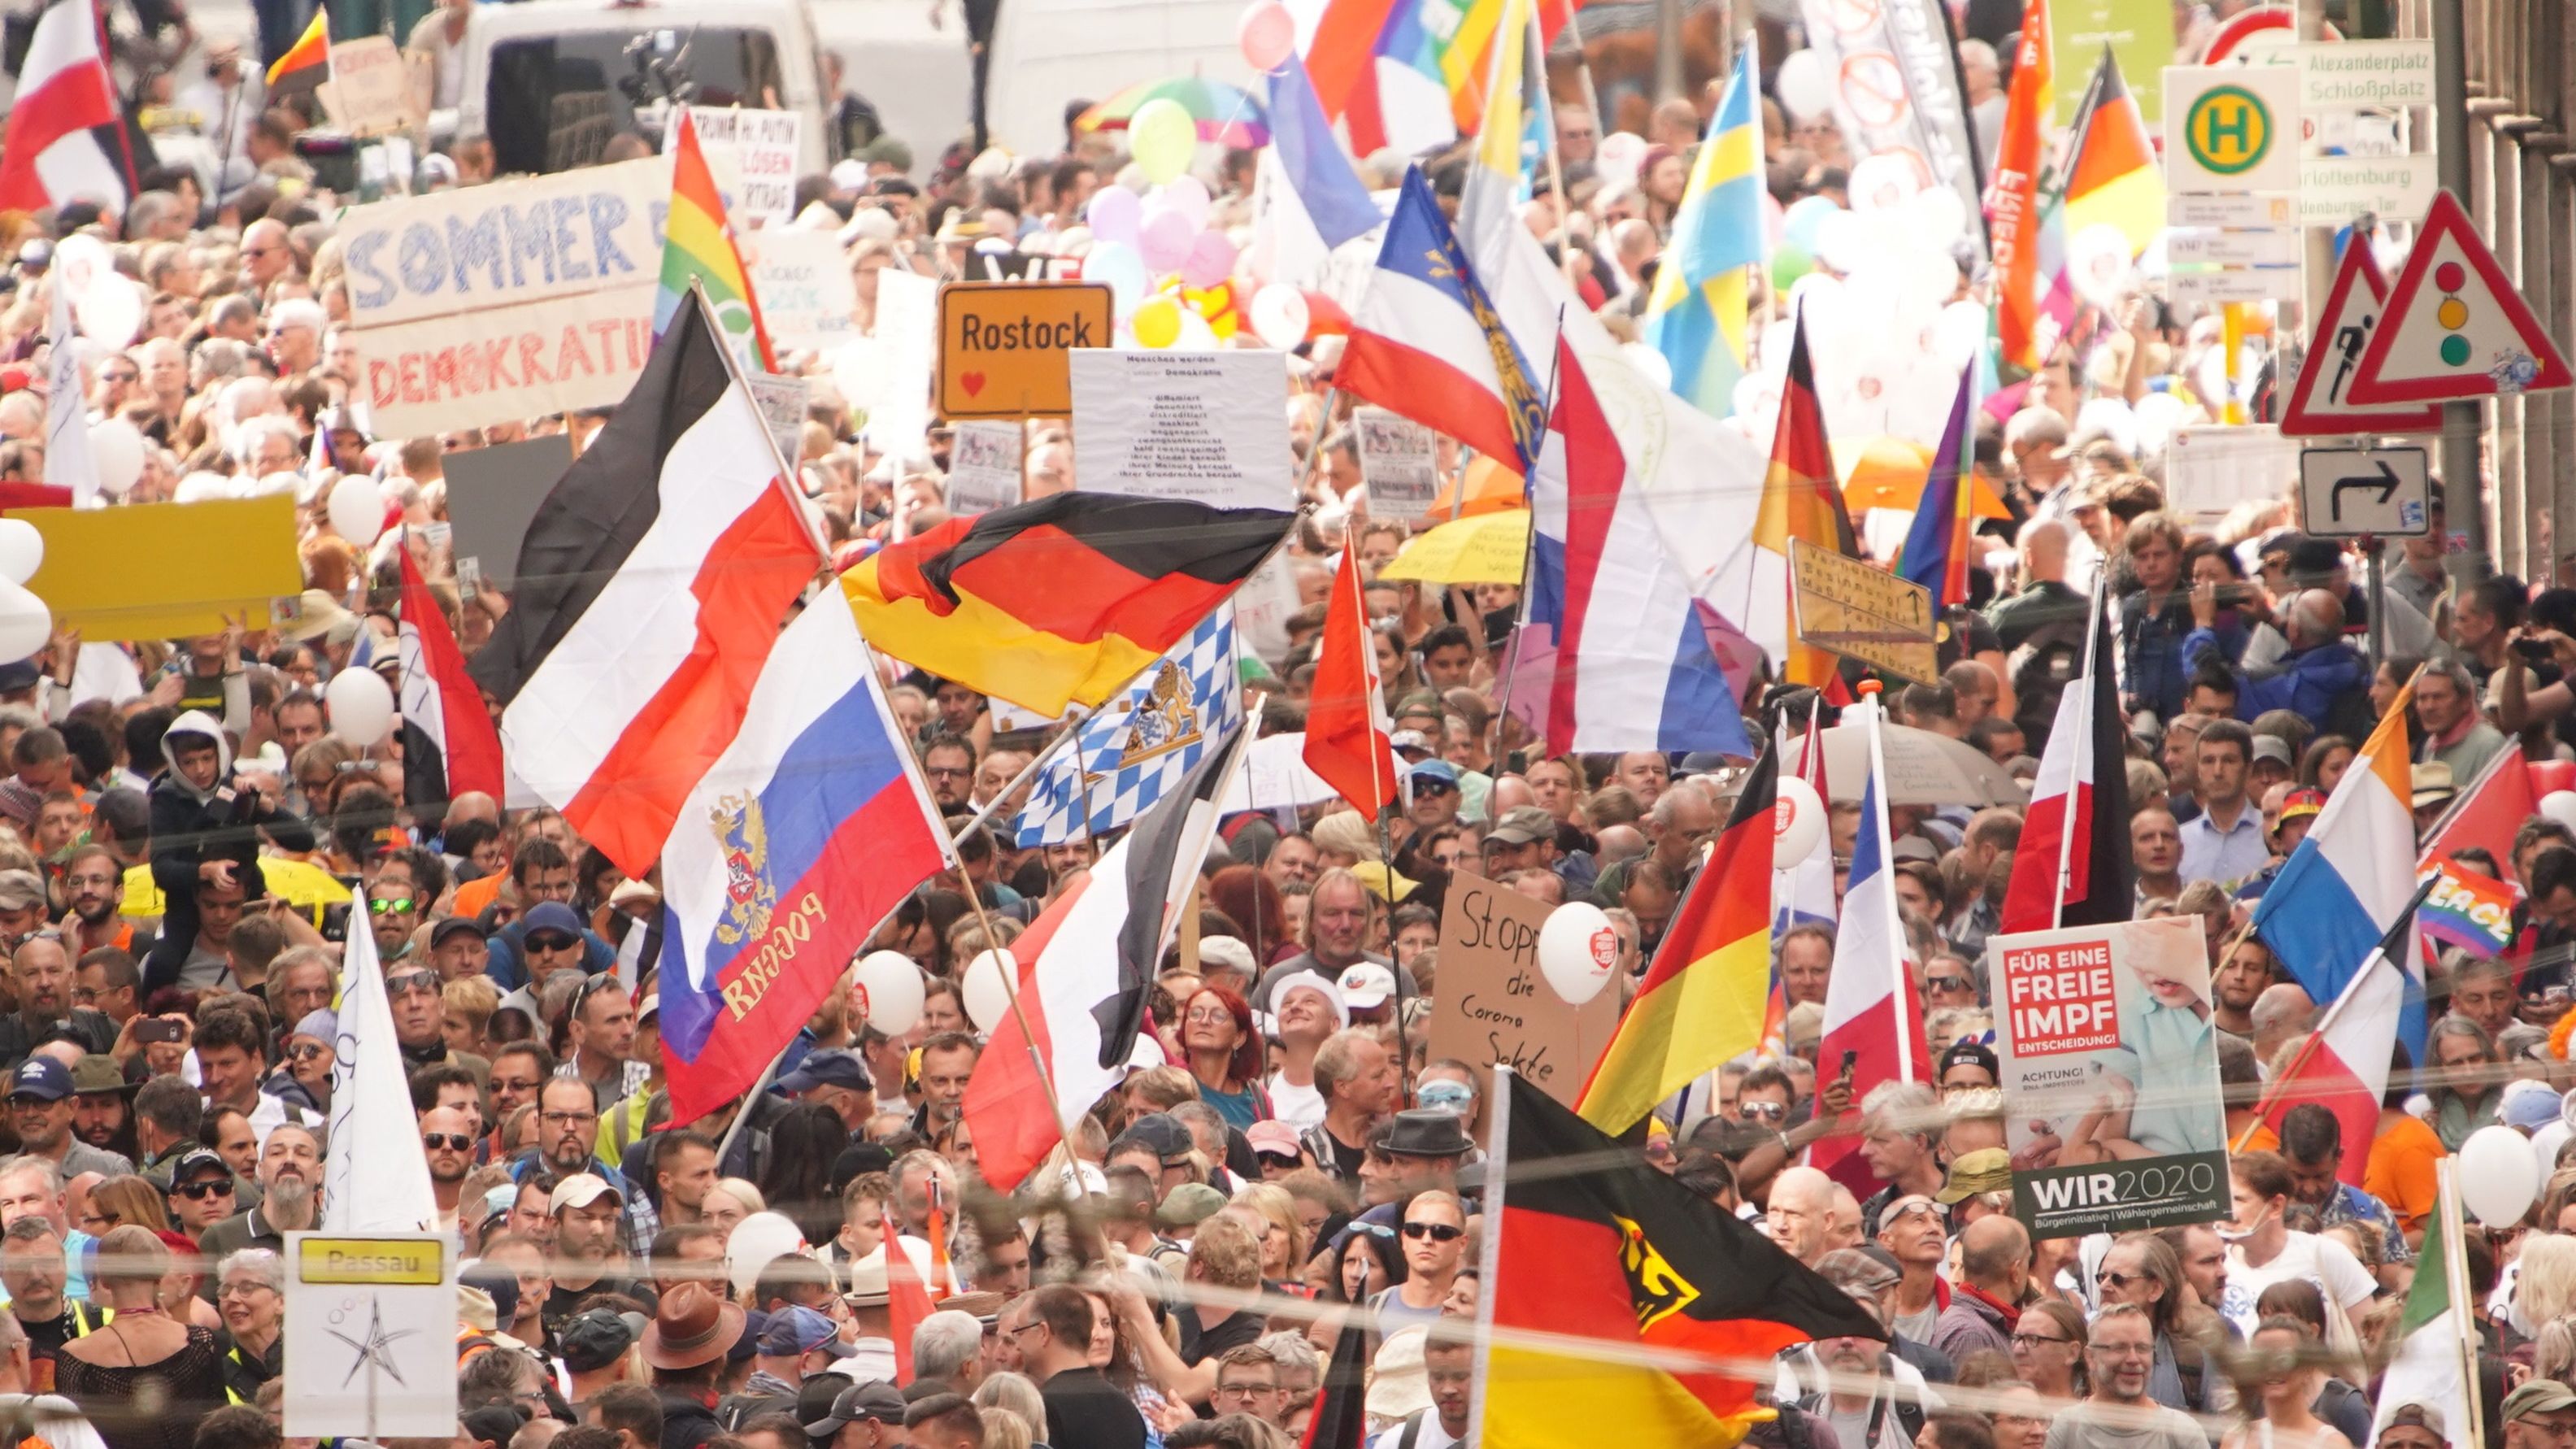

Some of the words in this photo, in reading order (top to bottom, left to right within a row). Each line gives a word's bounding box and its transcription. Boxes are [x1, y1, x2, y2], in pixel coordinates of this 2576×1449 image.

[2310, 52, 2429, 76] Alexanderplatz
[2310, 80, 2426, 100] Schloßplatz
[761, 116, 794, 144] PUTIN
[2208, 106, 2248, 153] H
[347, 192, 635, 309] SOMMER
[961, 311, 1091, 351] Rostock
[1126, 355, 1176, 363] Menschen
[1179, 355, 1216, 363] werden
[1165, 369, 1222, 377] Demokratie
[1151, 429, 1209, 437] weggesperrt
[1155, 462, 1194, 471] Meinung
[2008, 951, 2052, 974] FÜR
[2056, 946, 2108, 969] EINE
[1506, 970, 1535, 998] die
[2011, 968, 2113, 1004] FREIE
[1460, 994, 1523, 1029] Corona
[2013, 999, 2114, 1039] IMPF
[1482, 1030, 1554, 1081] Sekte
[2017, 1033, 2117, 1054] ENTSCHEIDUNG!
[2021, 1067, 2084, 1083] ACHTUNG!
[2030, 1162, 2215, 1210] WIR2020
[2034, 1212, 2111, 1229] Bürgerinitiative
[2116, 1199, 2218, 1222] Wählergemeinschaft
[328, 1250, 420, 1273] Passau
